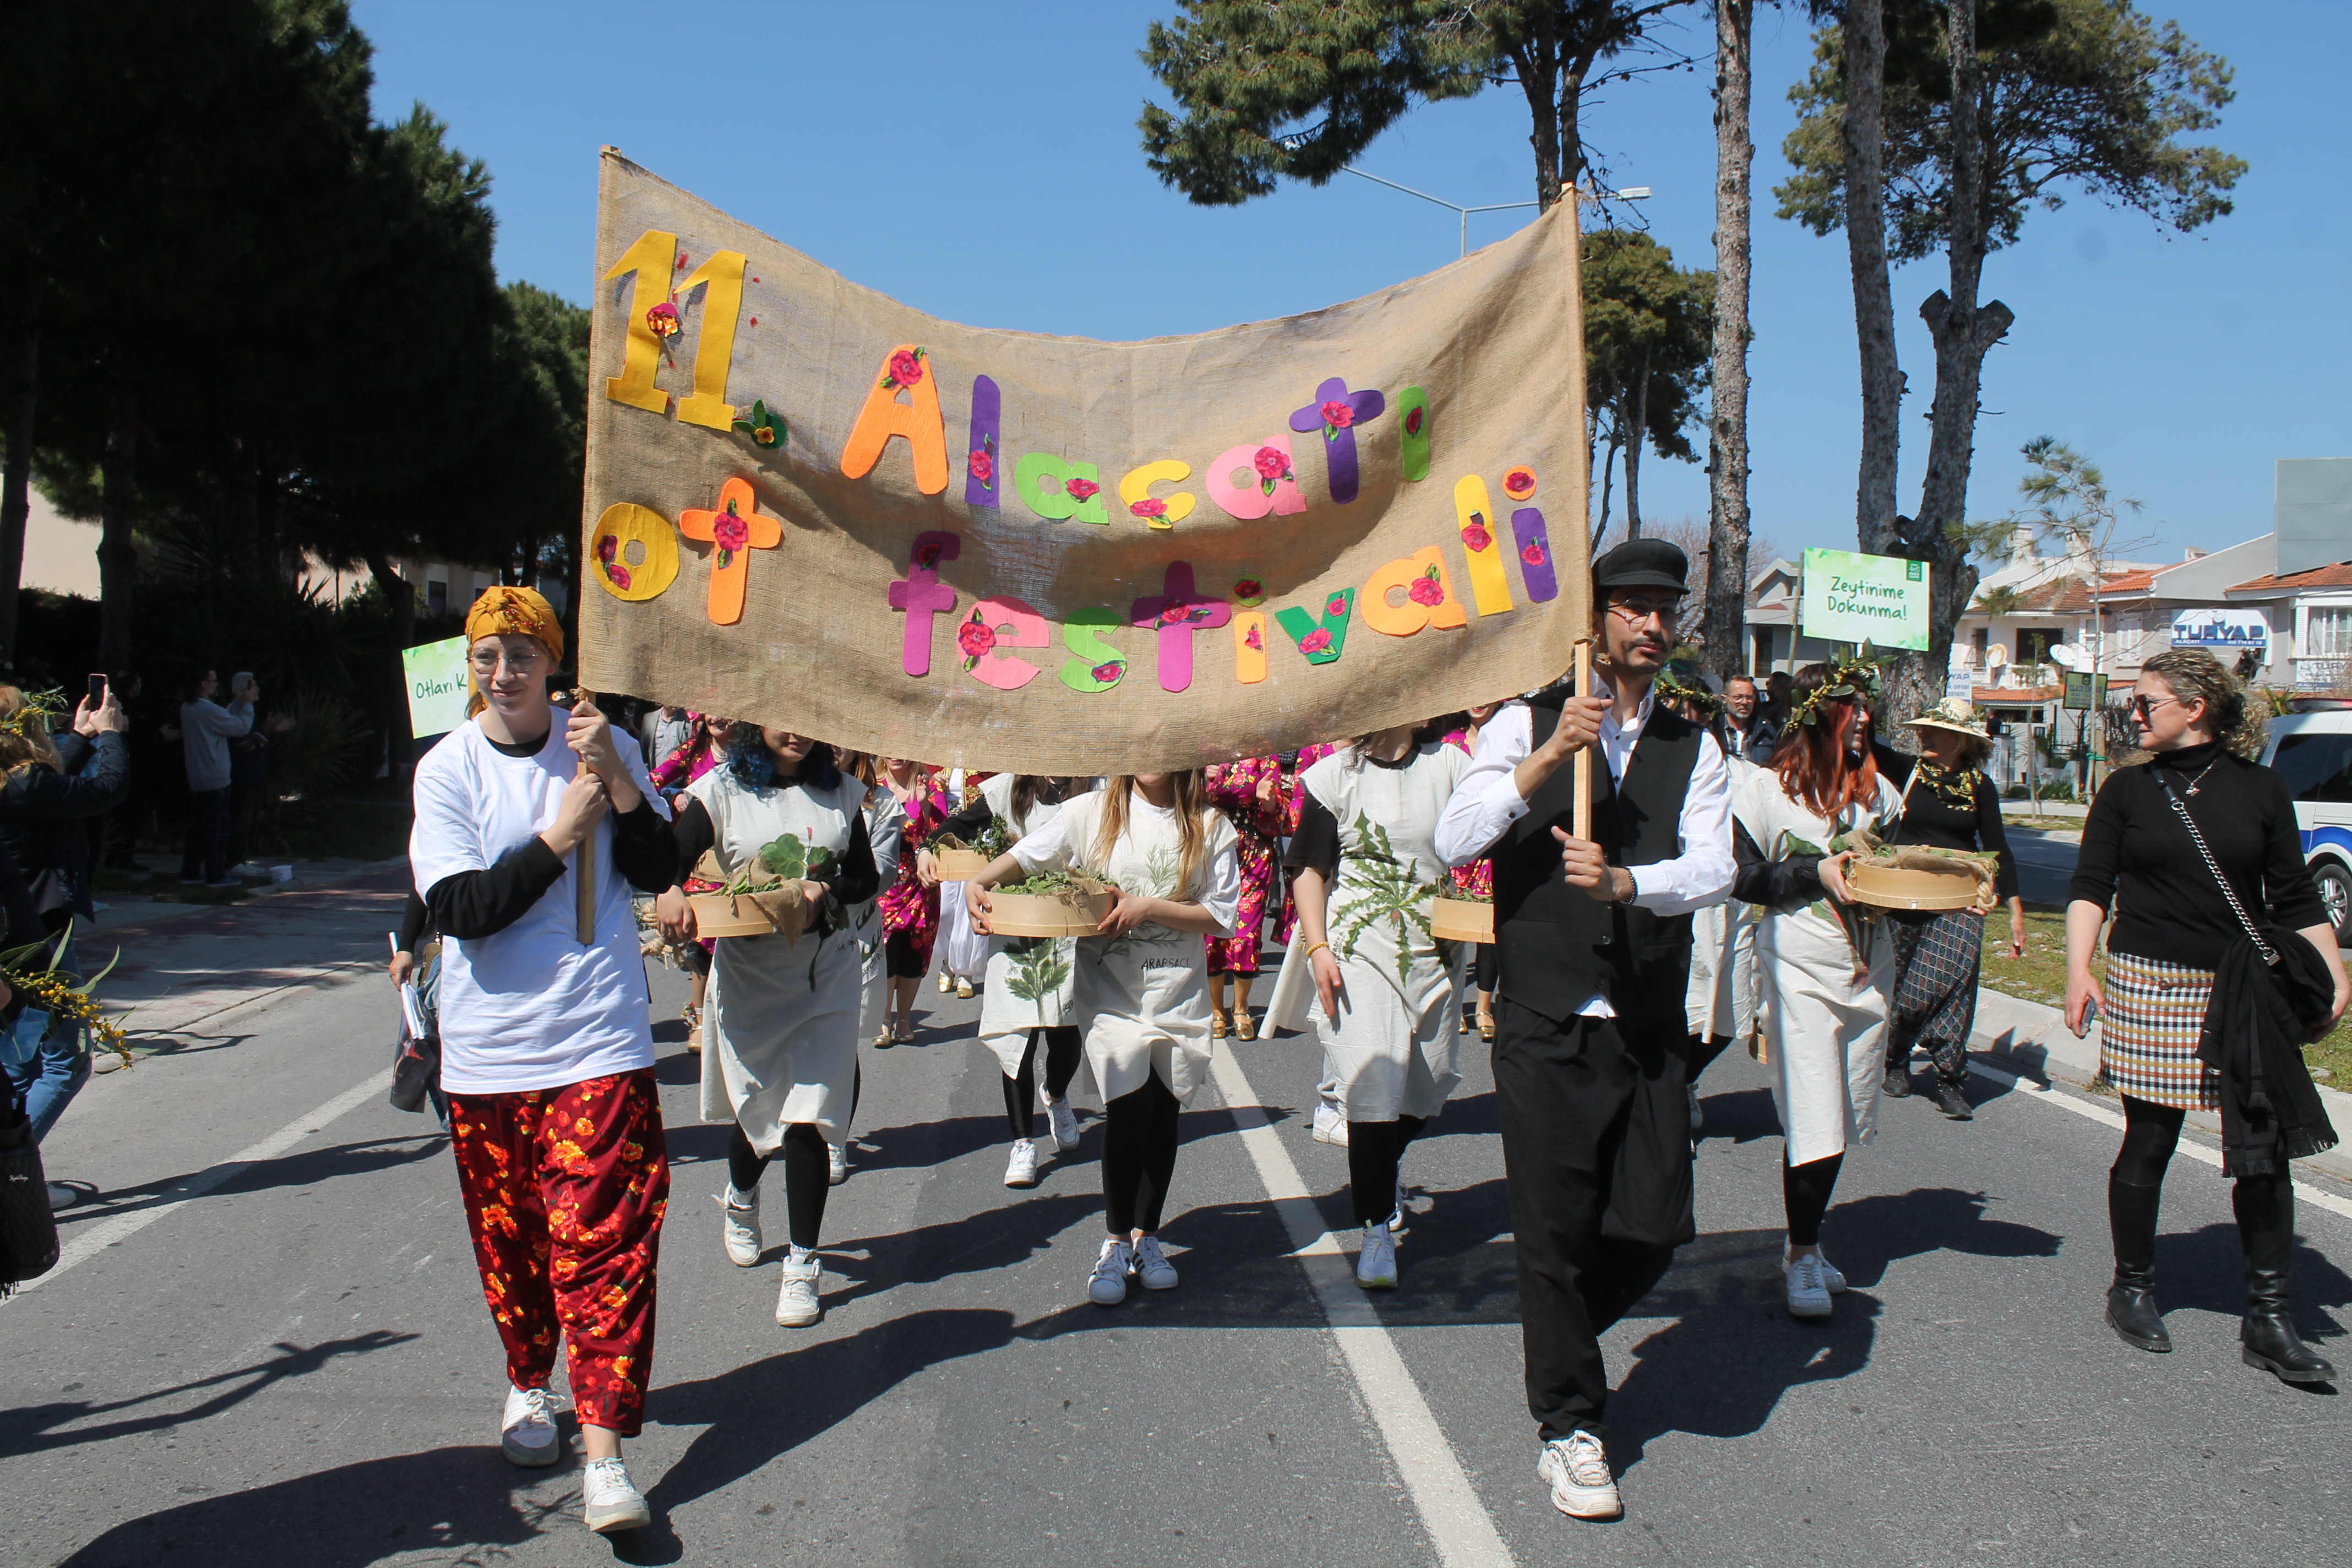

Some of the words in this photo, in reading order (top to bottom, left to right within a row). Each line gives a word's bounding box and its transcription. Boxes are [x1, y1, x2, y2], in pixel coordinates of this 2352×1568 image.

[840, 344, 1429, 530] Alaçatı
[888, 465, 1559, 694] festivali
[1831, 576, 1904, 600] Zeytinime
[1827, 596, 1908, 621] Dokunma!
[2174, 624, 2264, 640] TURYAP
[416, 678, 453, 699] Otları
[456, 673, 467, 691] K
[1063, 999, 1074, 1016] ISIR
